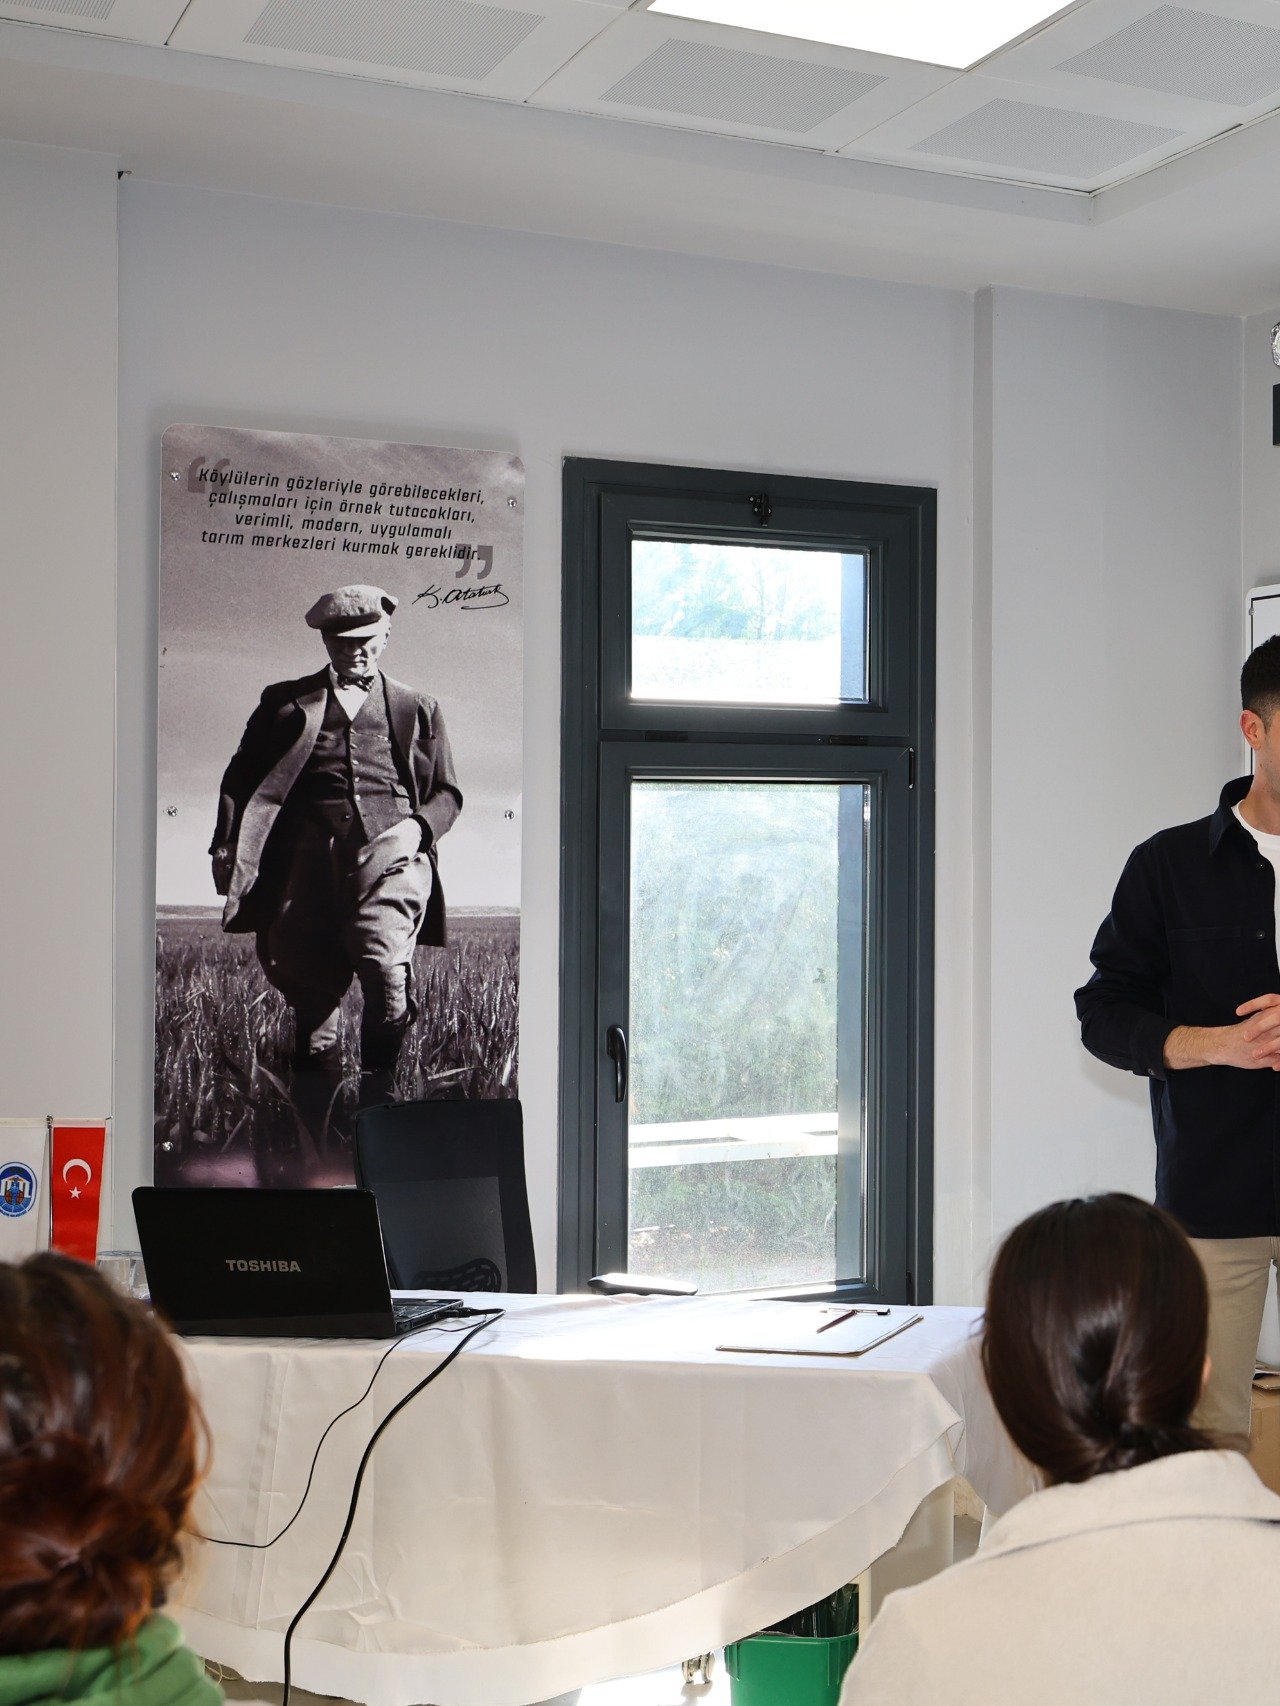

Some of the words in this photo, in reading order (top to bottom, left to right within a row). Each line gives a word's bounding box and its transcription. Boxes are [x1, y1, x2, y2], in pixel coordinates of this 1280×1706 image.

[199, 468, 280, 488] Köylülerin
[286, 476, 363, 496] gözleriyle
[369, 482, 485, 505] görebilecekleri,
[208, 490, 298, 510] çalışmaları
[304, 496, 333, 515] için
[339, 499, 383, 516] örnek
[389, 501, 475, 523] tutacakları,
[235, 512, 294, 530] verimli,
[301, 518, 363, 535] modern,
[370, 523, 452, 539] uygulamalı
[201, 530, 245, 545] tarım
[251, 534, 337, 551] merkezleri
[342, 538, 400, 556] kurmak
[405, 544, 481, 561] gereklidir.
[226, 1259, 301, 1272] TOSHIBA
